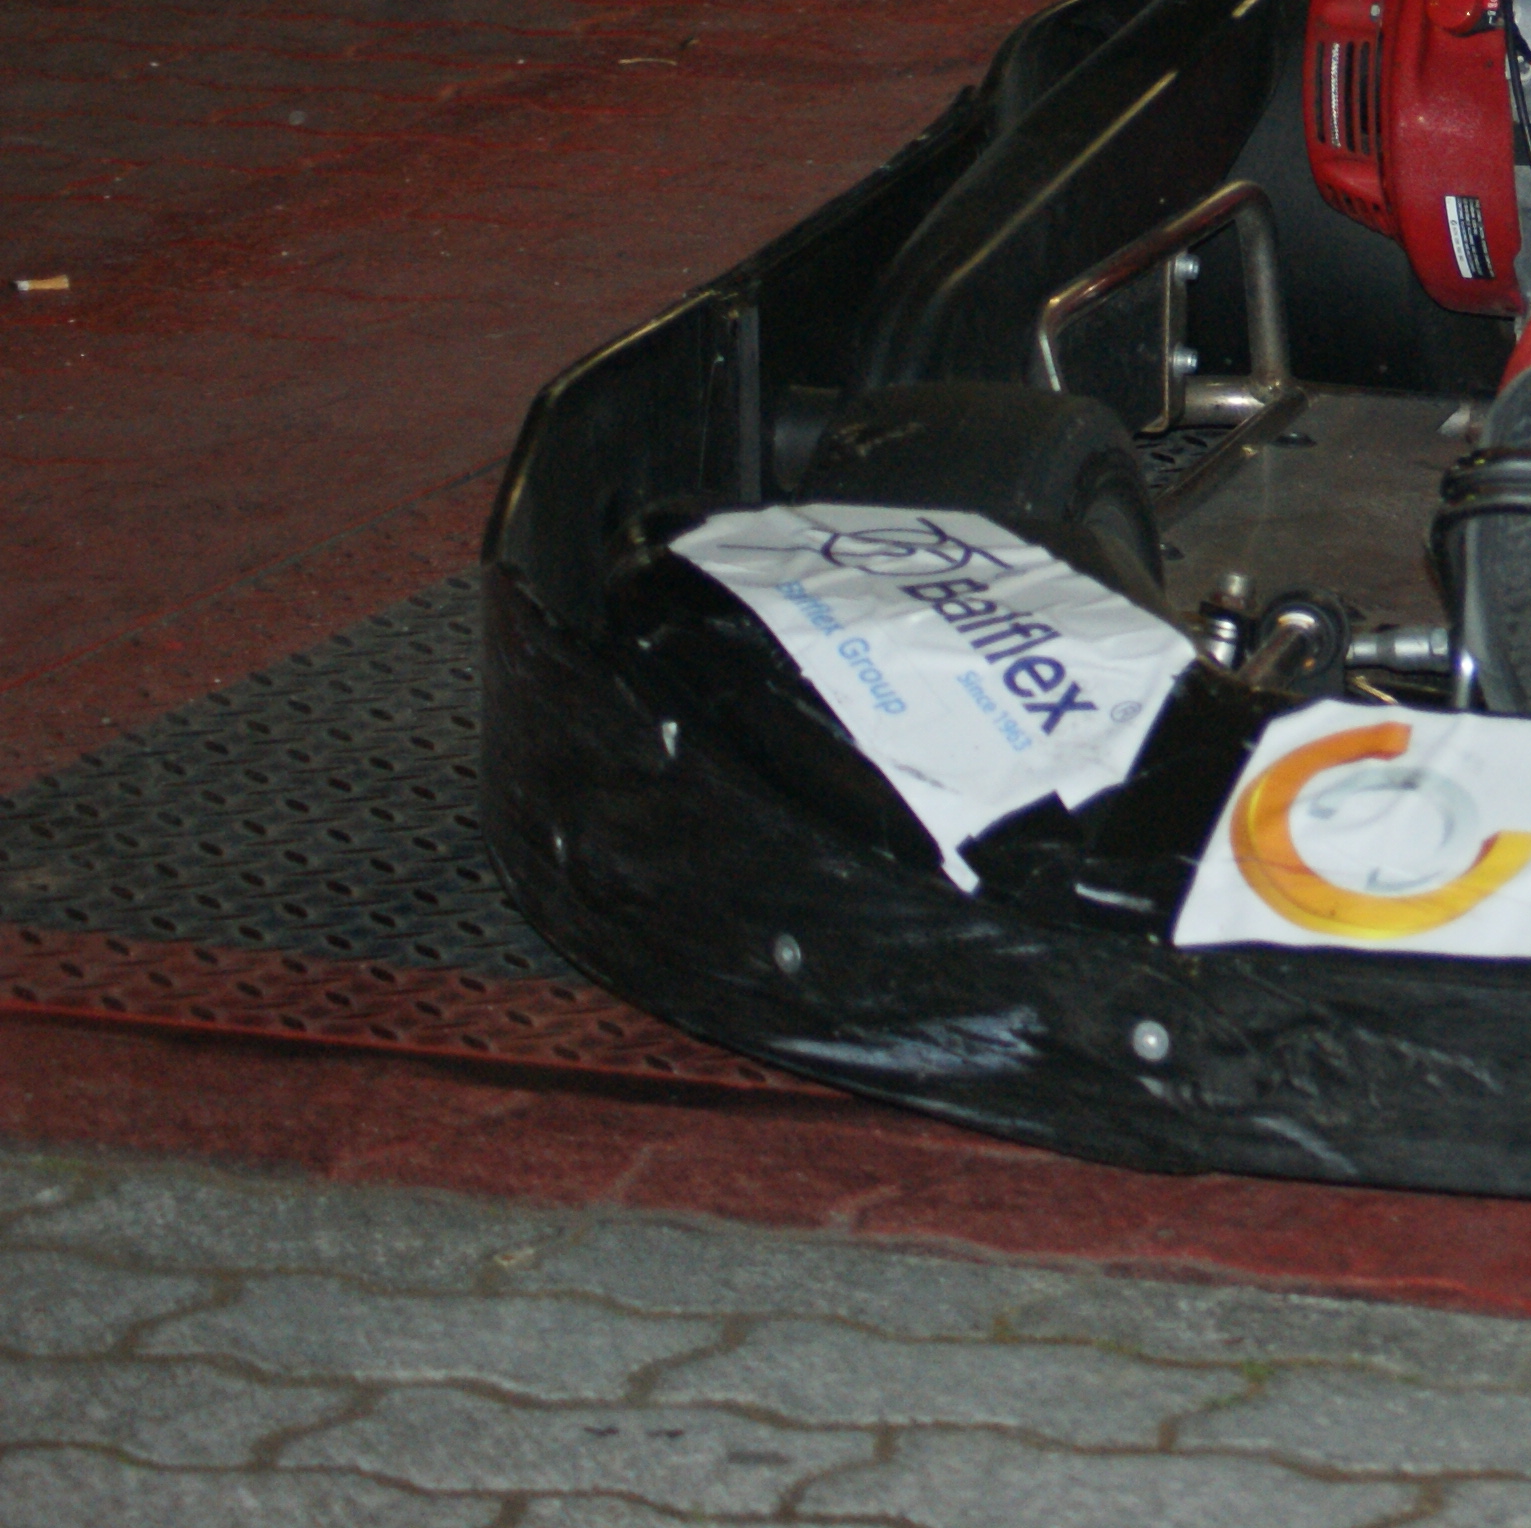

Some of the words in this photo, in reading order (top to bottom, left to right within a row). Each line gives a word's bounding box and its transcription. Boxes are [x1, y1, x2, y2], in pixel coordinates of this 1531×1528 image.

[837, 637, 907, 715] Group
[898, 577, 1098, 736] Balflex
[956, 670, 998, 714] Since
